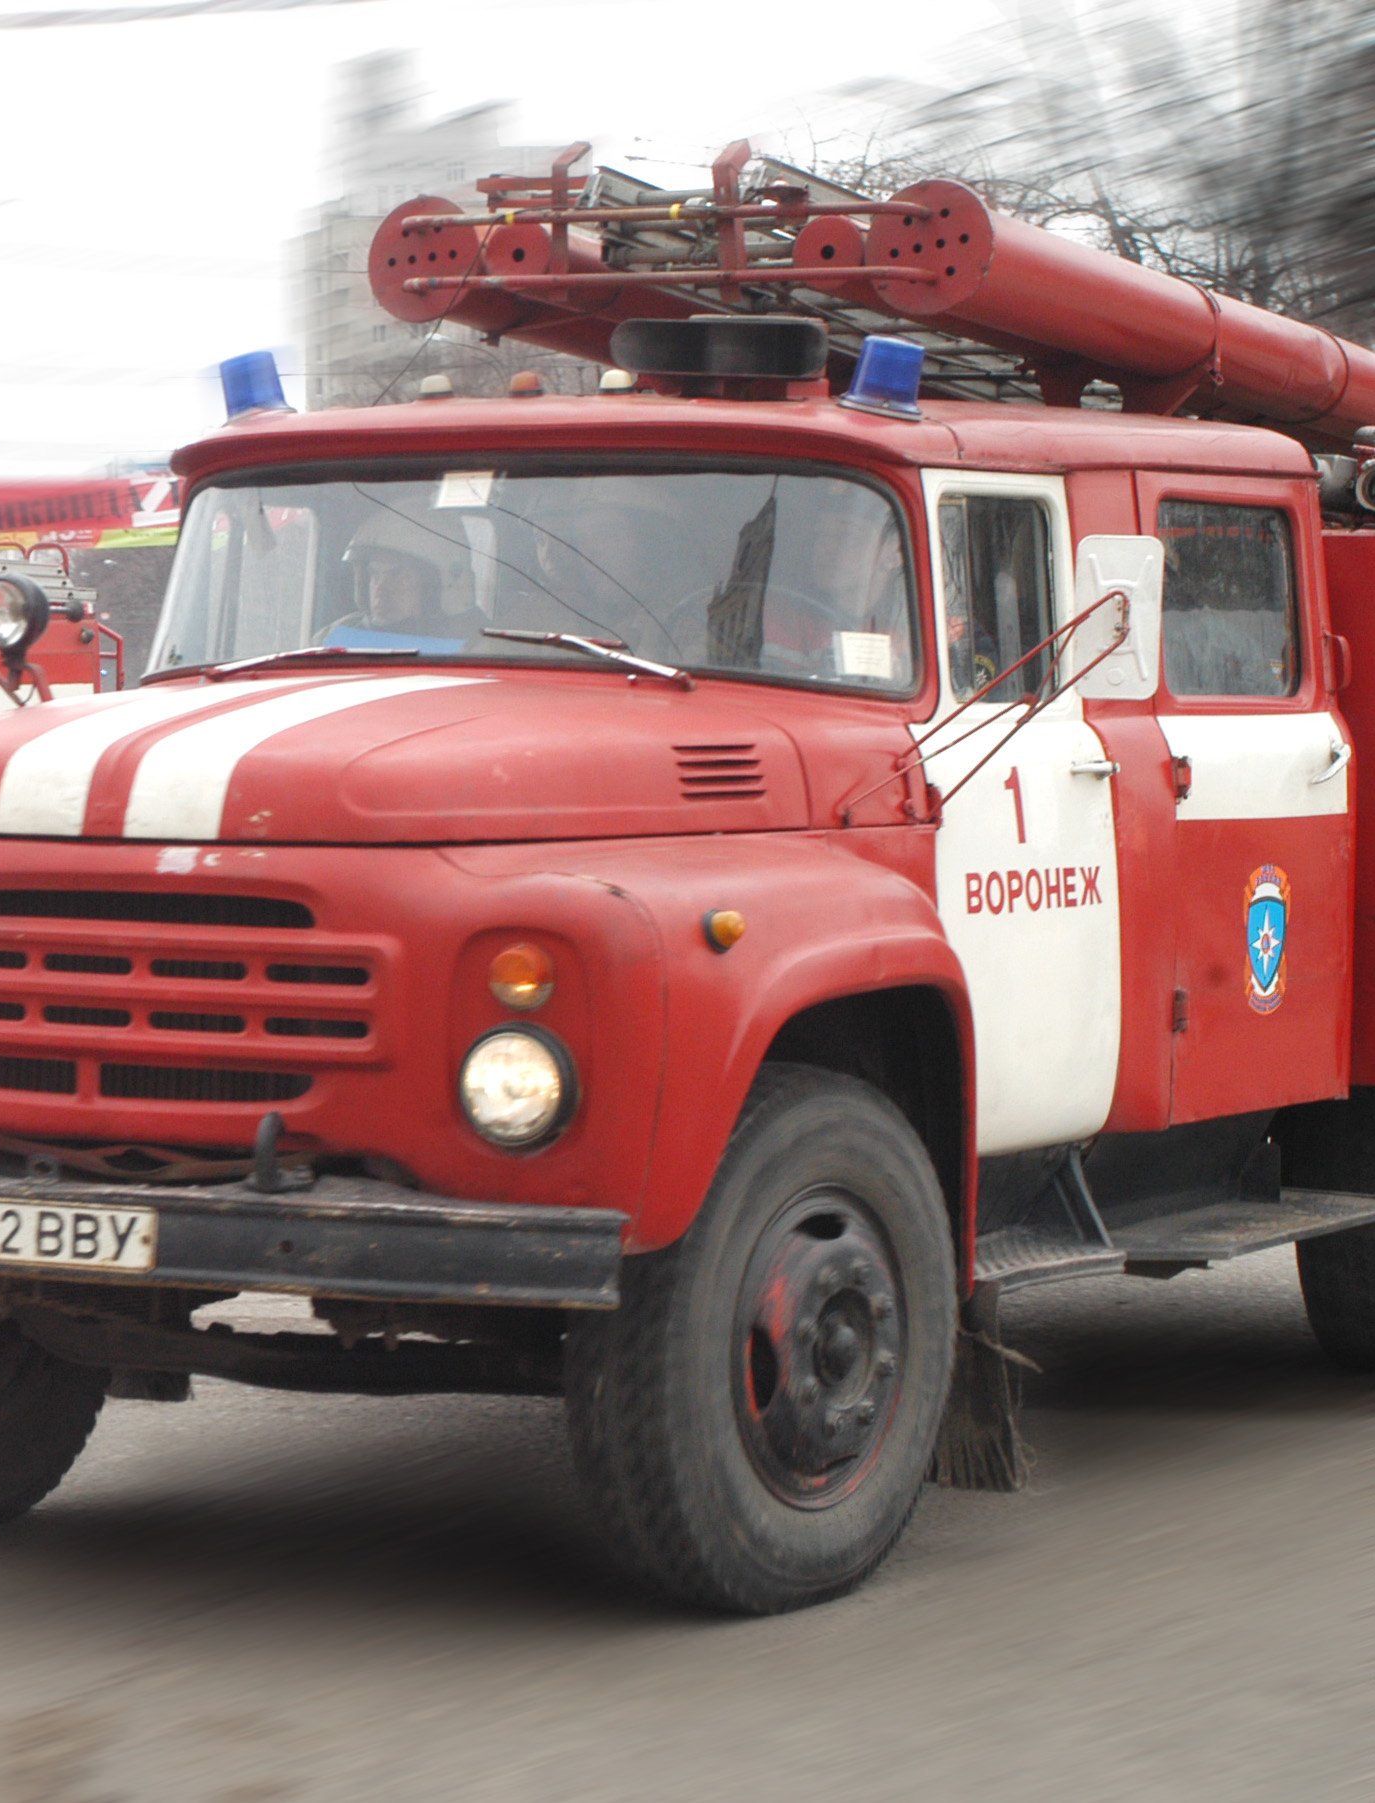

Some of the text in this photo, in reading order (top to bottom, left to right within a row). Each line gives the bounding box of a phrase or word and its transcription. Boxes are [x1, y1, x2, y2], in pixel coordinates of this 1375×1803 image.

[1004, 766, 1026, 844] 1
[966, 866, 1103, 915] ВОРОНЕЖ
[36, 1211, 138, 1261] ВВУ
